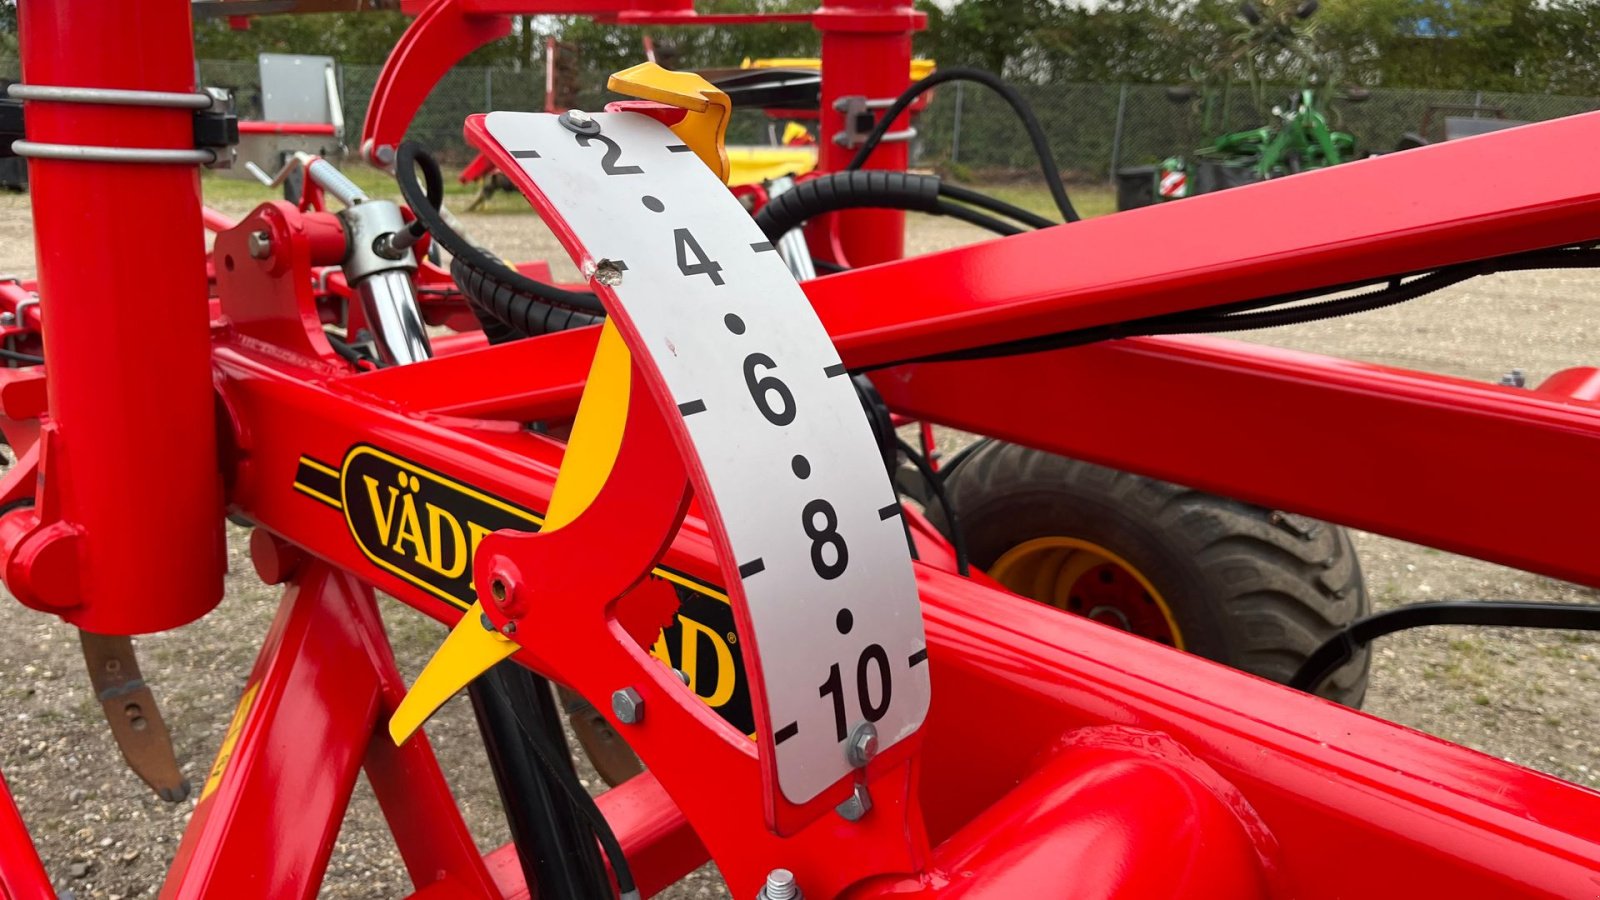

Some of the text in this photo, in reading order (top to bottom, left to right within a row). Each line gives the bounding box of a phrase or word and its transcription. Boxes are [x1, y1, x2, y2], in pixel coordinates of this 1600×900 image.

[575, 131, 645, 176] 2
[673, 228, 725, 286] 4
[743, 352, 797, 426] 6
[801, 499, 849, 580] 8
[819, 643, 892, 743] 10
